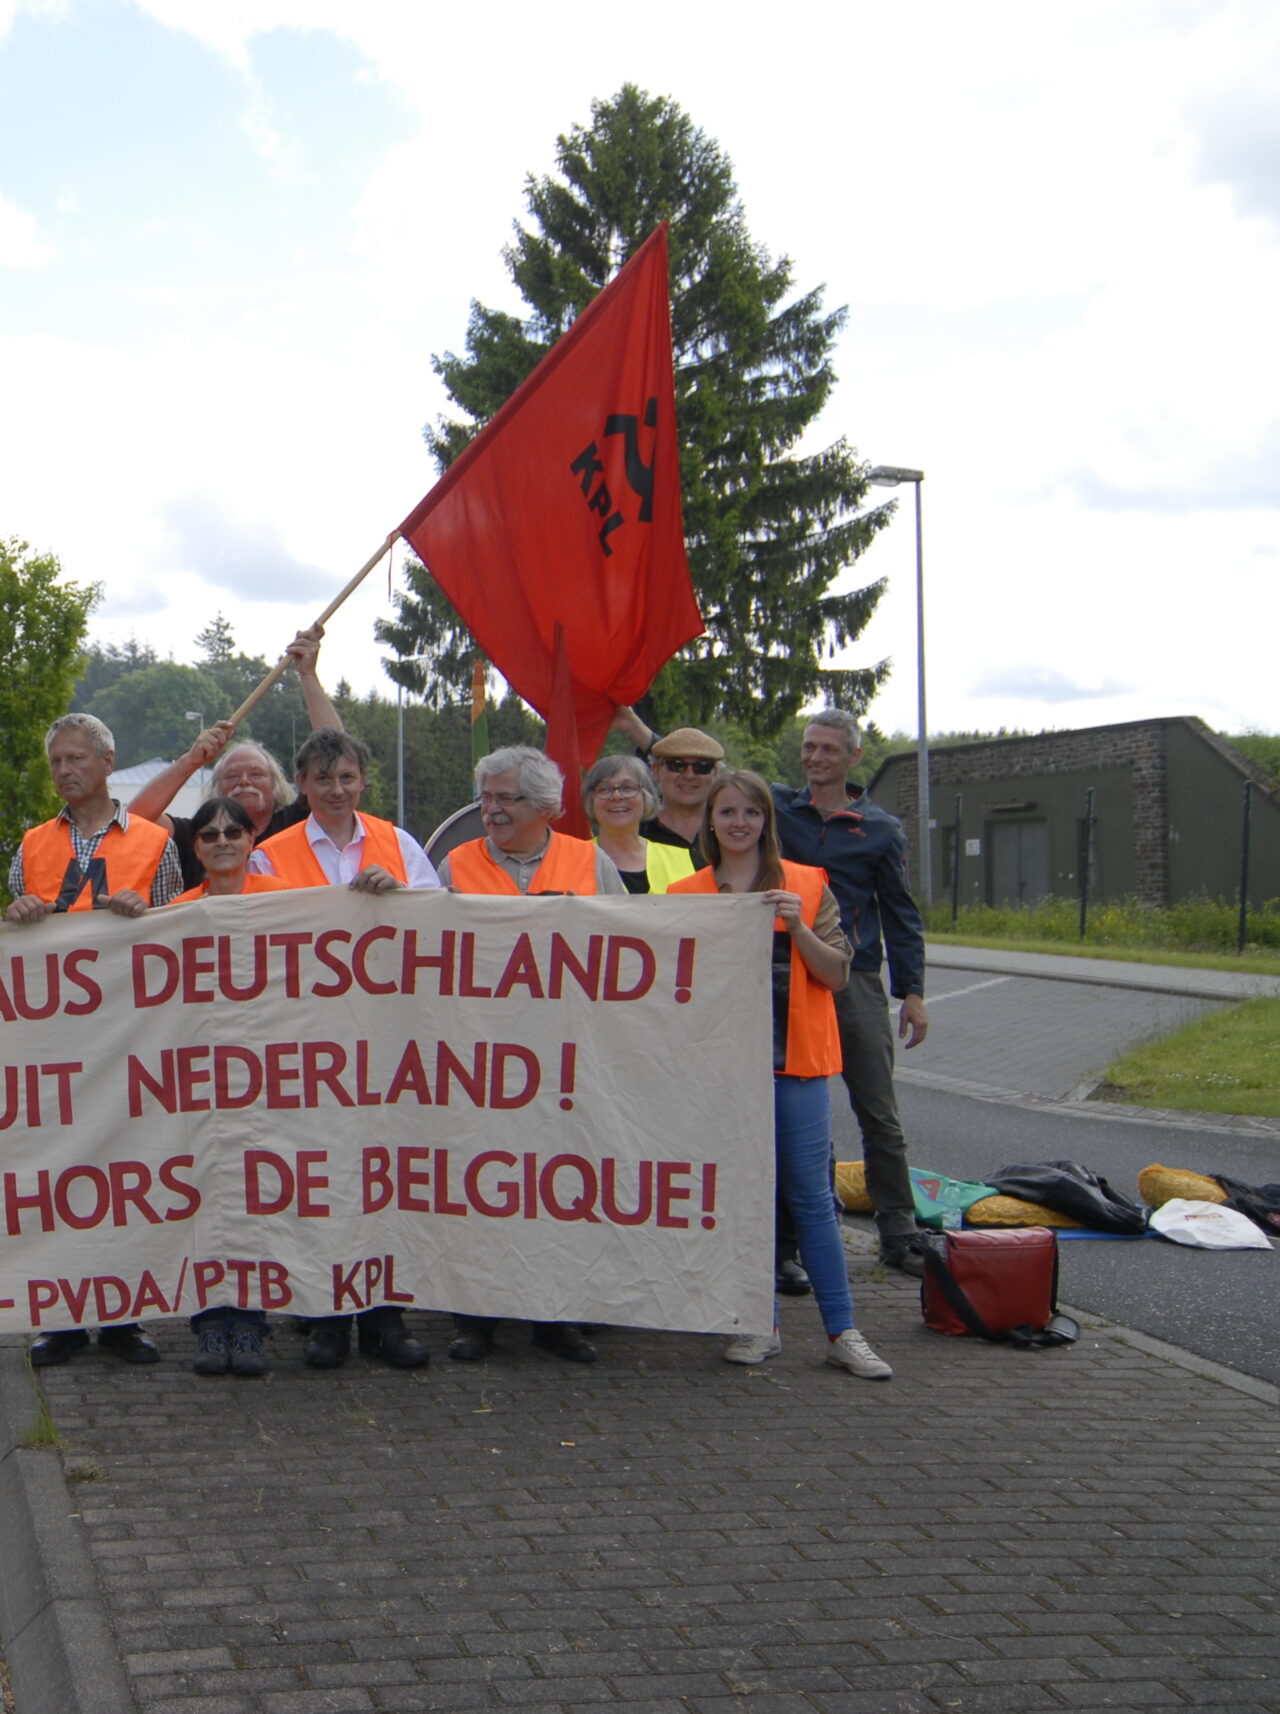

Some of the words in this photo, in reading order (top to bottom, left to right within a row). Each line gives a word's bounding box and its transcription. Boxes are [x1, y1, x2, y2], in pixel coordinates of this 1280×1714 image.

[570, 440, 625, 558] KPL
[4, 1153, 202, 1237] HORS
[244, 1149, 330, 1219] DE
[362, 1145, 717, 1230] BELGIQUE!
[27, 1256, 293, 1326] PVDA/PTB
[333, 1254, 413, 1311] KPL
